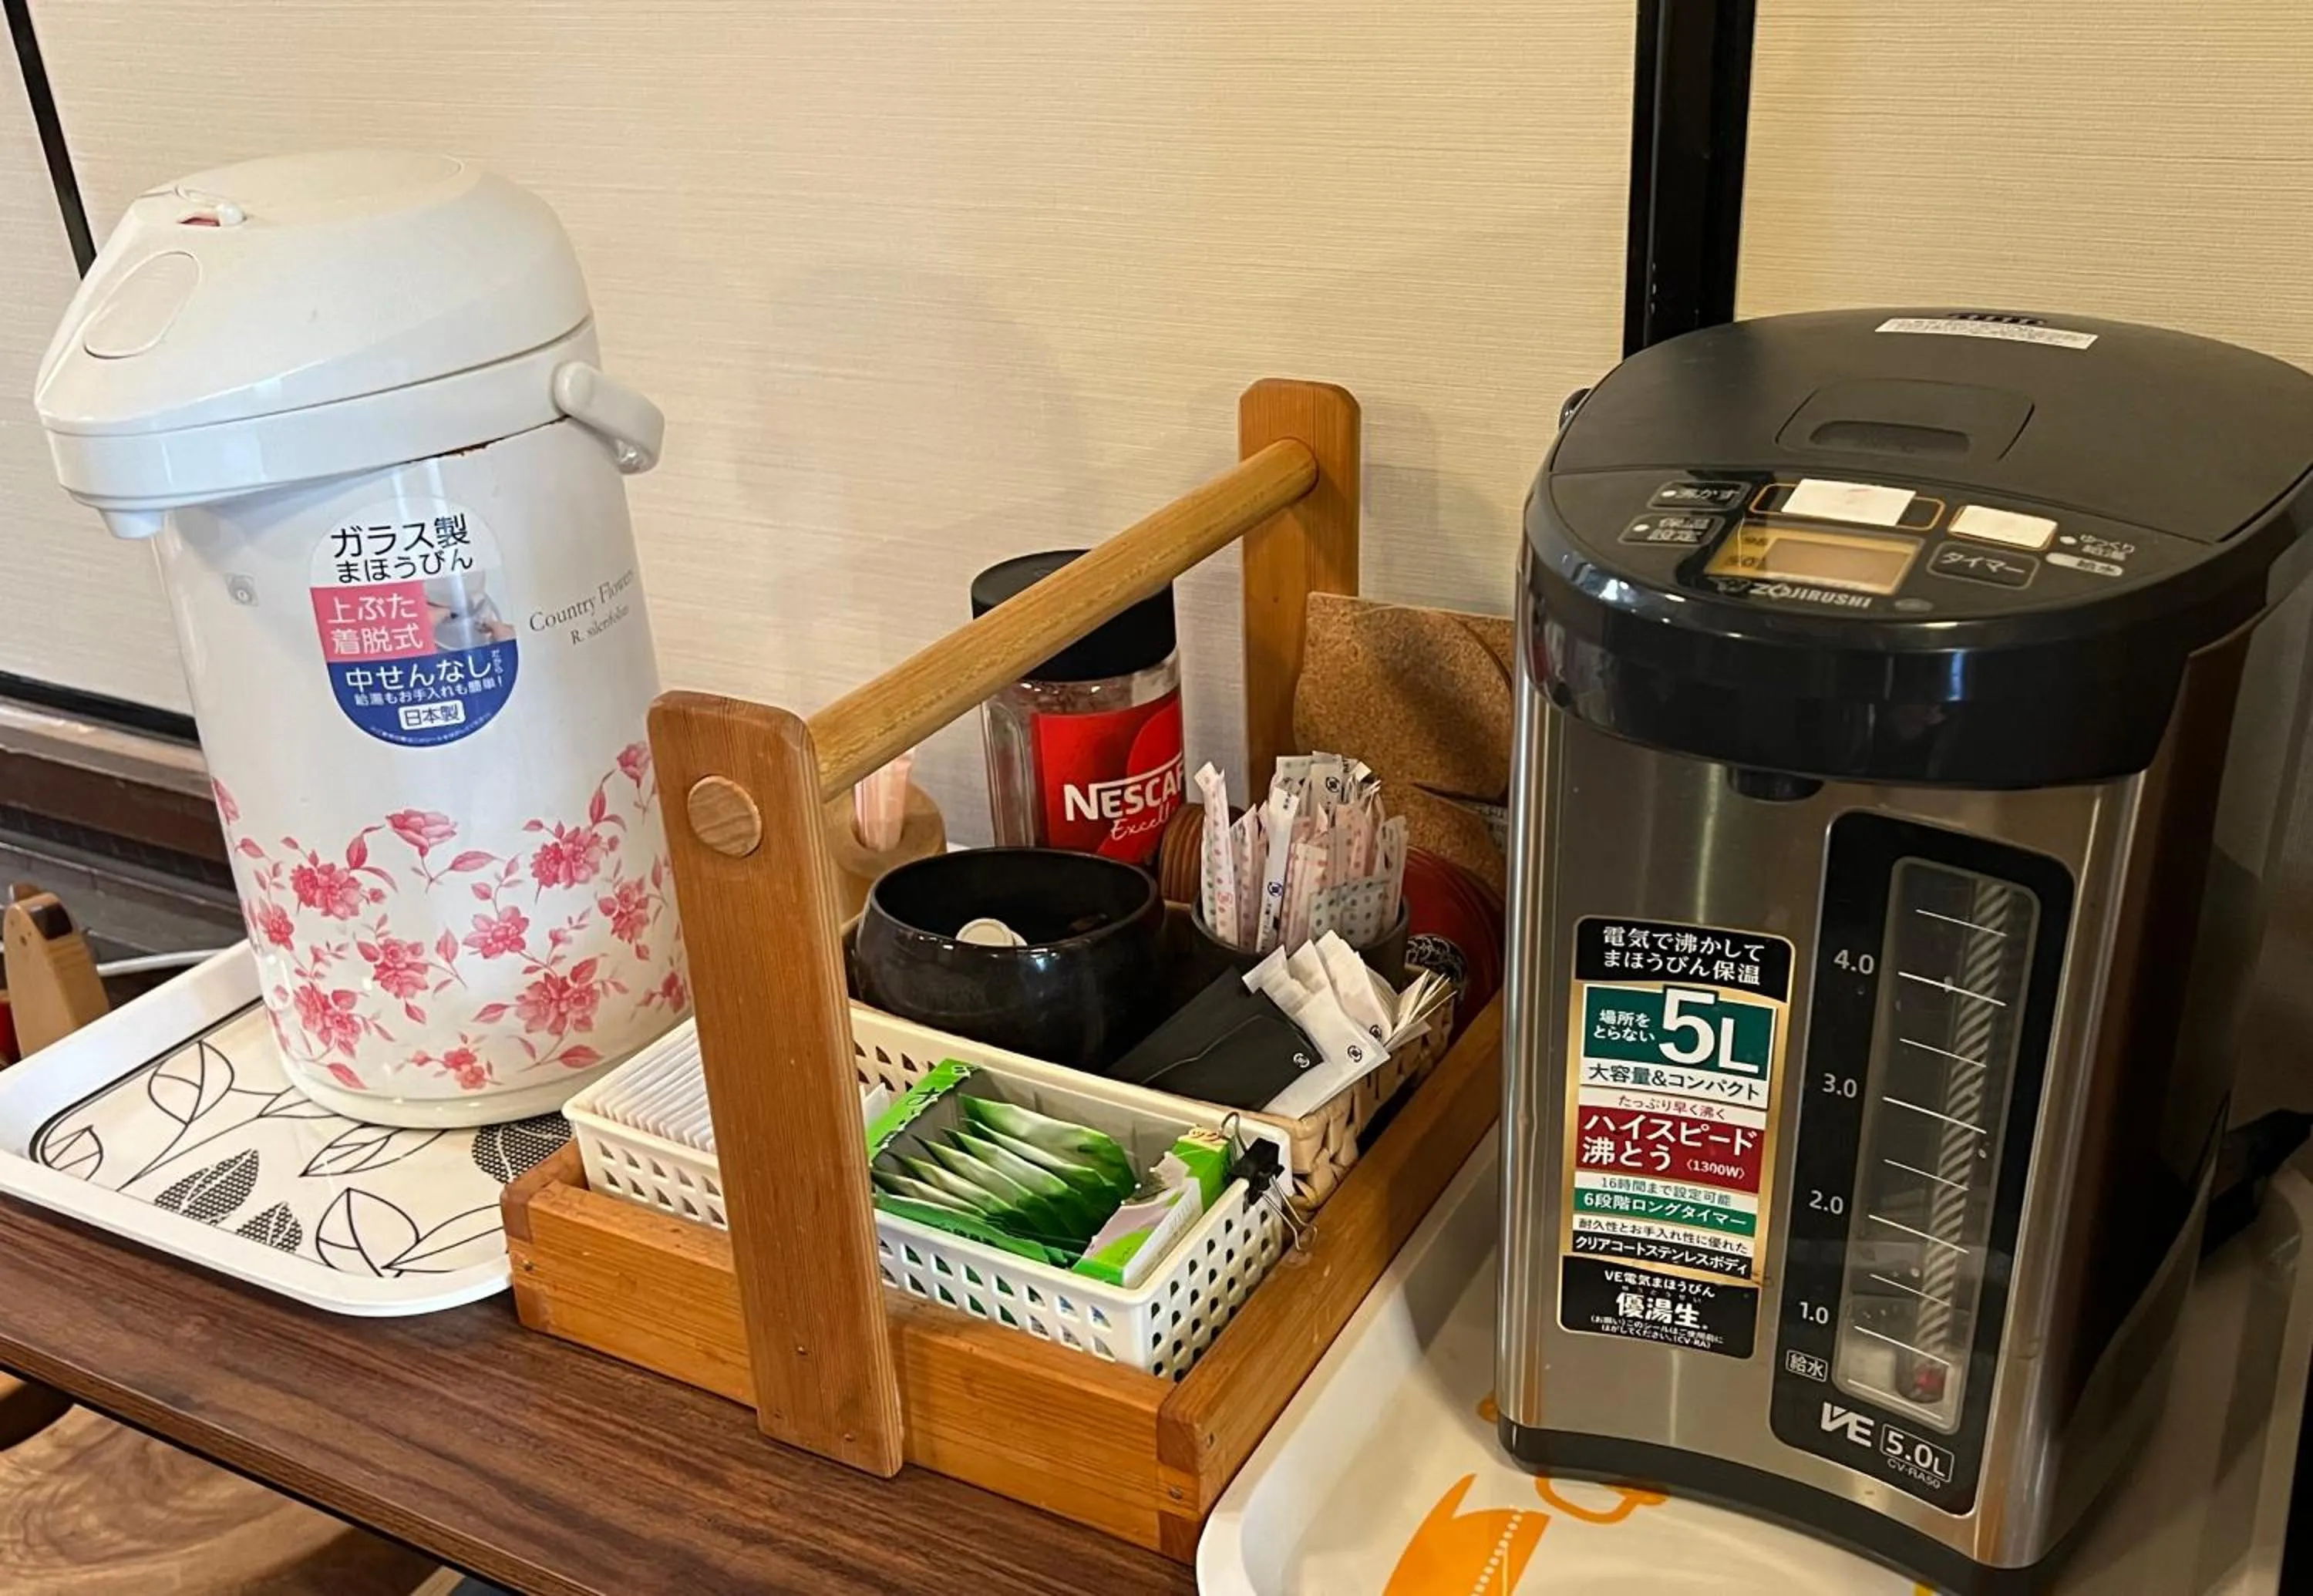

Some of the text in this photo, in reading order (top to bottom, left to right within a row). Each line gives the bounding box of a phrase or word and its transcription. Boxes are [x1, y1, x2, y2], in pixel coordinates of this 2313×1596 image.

[331, 513, 471, 558] ガラス製
[337, 548, 473, 584] まほうびん
[1941, 551, 2025, 574] タイマー
[328, 592, 418, 625] 上ぶた
[1749, 582, 1873, 609] ZOJIRUSHI
[530, 595, 595, 631] Country
[332, 625, 423, 654] 着脱式
[346, 655, 491, 692] 中せんなし
[404, 704, 460, 727] 日本製
[1063, 757, 1183, 821] NESCAF
[1604, 926, 1765, 962] 電気で沸かして
[1604, 950, 1760, 985] まほうびん保温
[1833, 949, 1874, 975] 4.0
[1594, 1025, 1655, 1042] とらない
[1599, 1009, 1651, 1029] 場所を
[1658, 988, 1760, 1074] 5L
[1822, 1073, 1857, 1098] 3.0
[1619, 1095, 1726, 1120] たっぷり早く沸く
[1584, 1113, 1758, 1156] ハイスピード
[1581, 1136, 1672, 1172] 沸とう
[1601, 1177, 1731, 1207] 16時間まで設定可能
[1808, 1190, 1843, 1215] 2.0
[1584, 1193, 1747, 1225] 6段階ロングタイマー
[1578, 1217, 1749, 1254] 耐久性とお手入れ性に優れた
[1575, 1235, 1748, 1275] クリアコートステンレスボディ
[1799, 1301, 1829, 1325] 1.0
[1789, 1353, 1825, 1379] 給水
[1820, 1402, 1874, 1447] VE
[1887, 1458, 1941, 1489] CV-RA50
